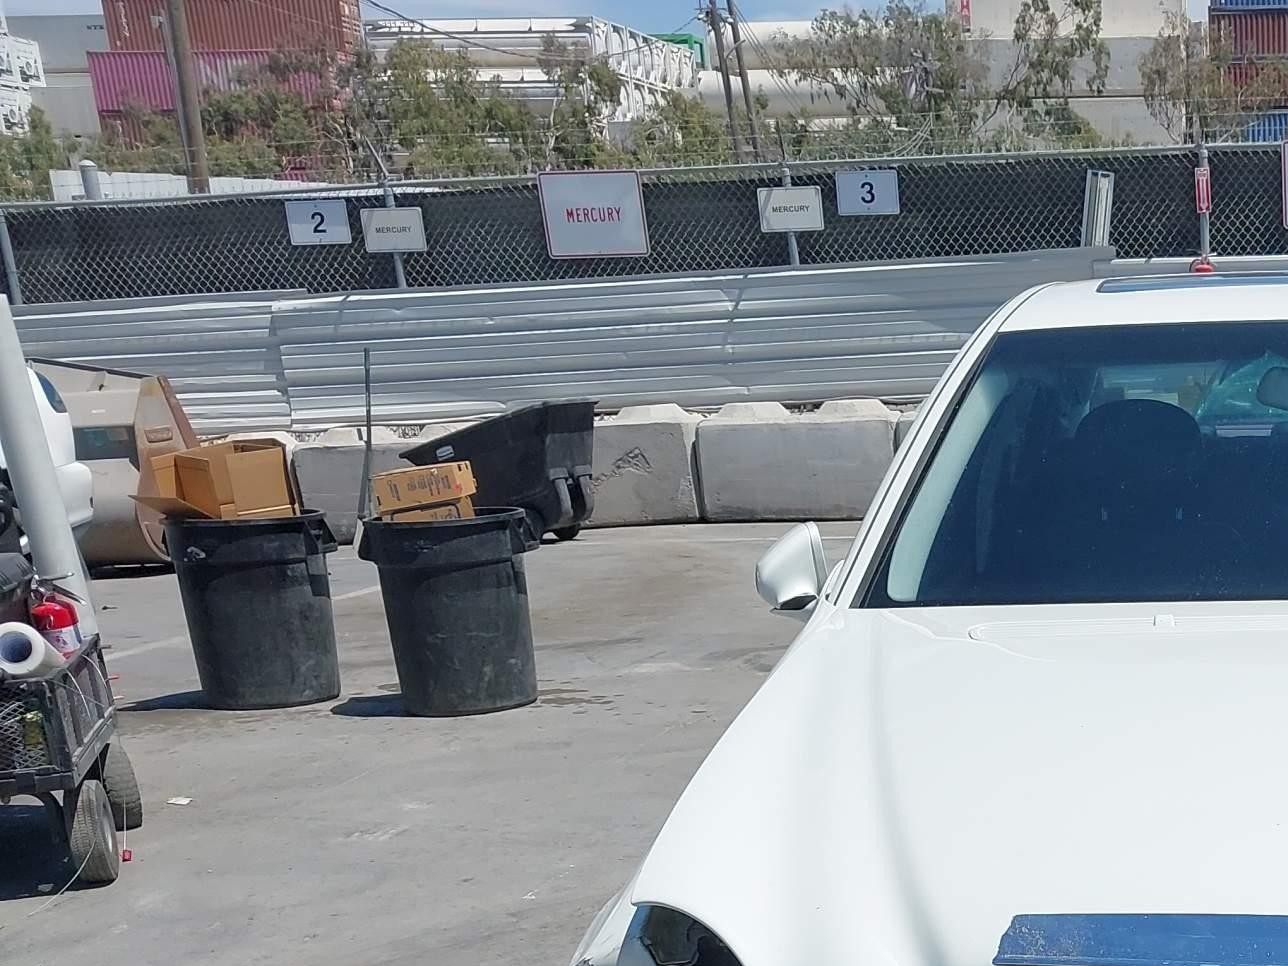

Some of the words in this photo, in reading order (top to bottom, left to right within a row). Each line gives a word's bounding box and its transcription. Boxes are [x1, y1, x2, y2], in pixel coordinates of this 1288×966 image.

[860, 182, 875, 204] 3
[566, 207, 621, 223] MERCURY
[771, 204, 810, 213] MERCURY
[311, 211, 327, 233] 2
[375, 225, 412, 234] MERCURY
